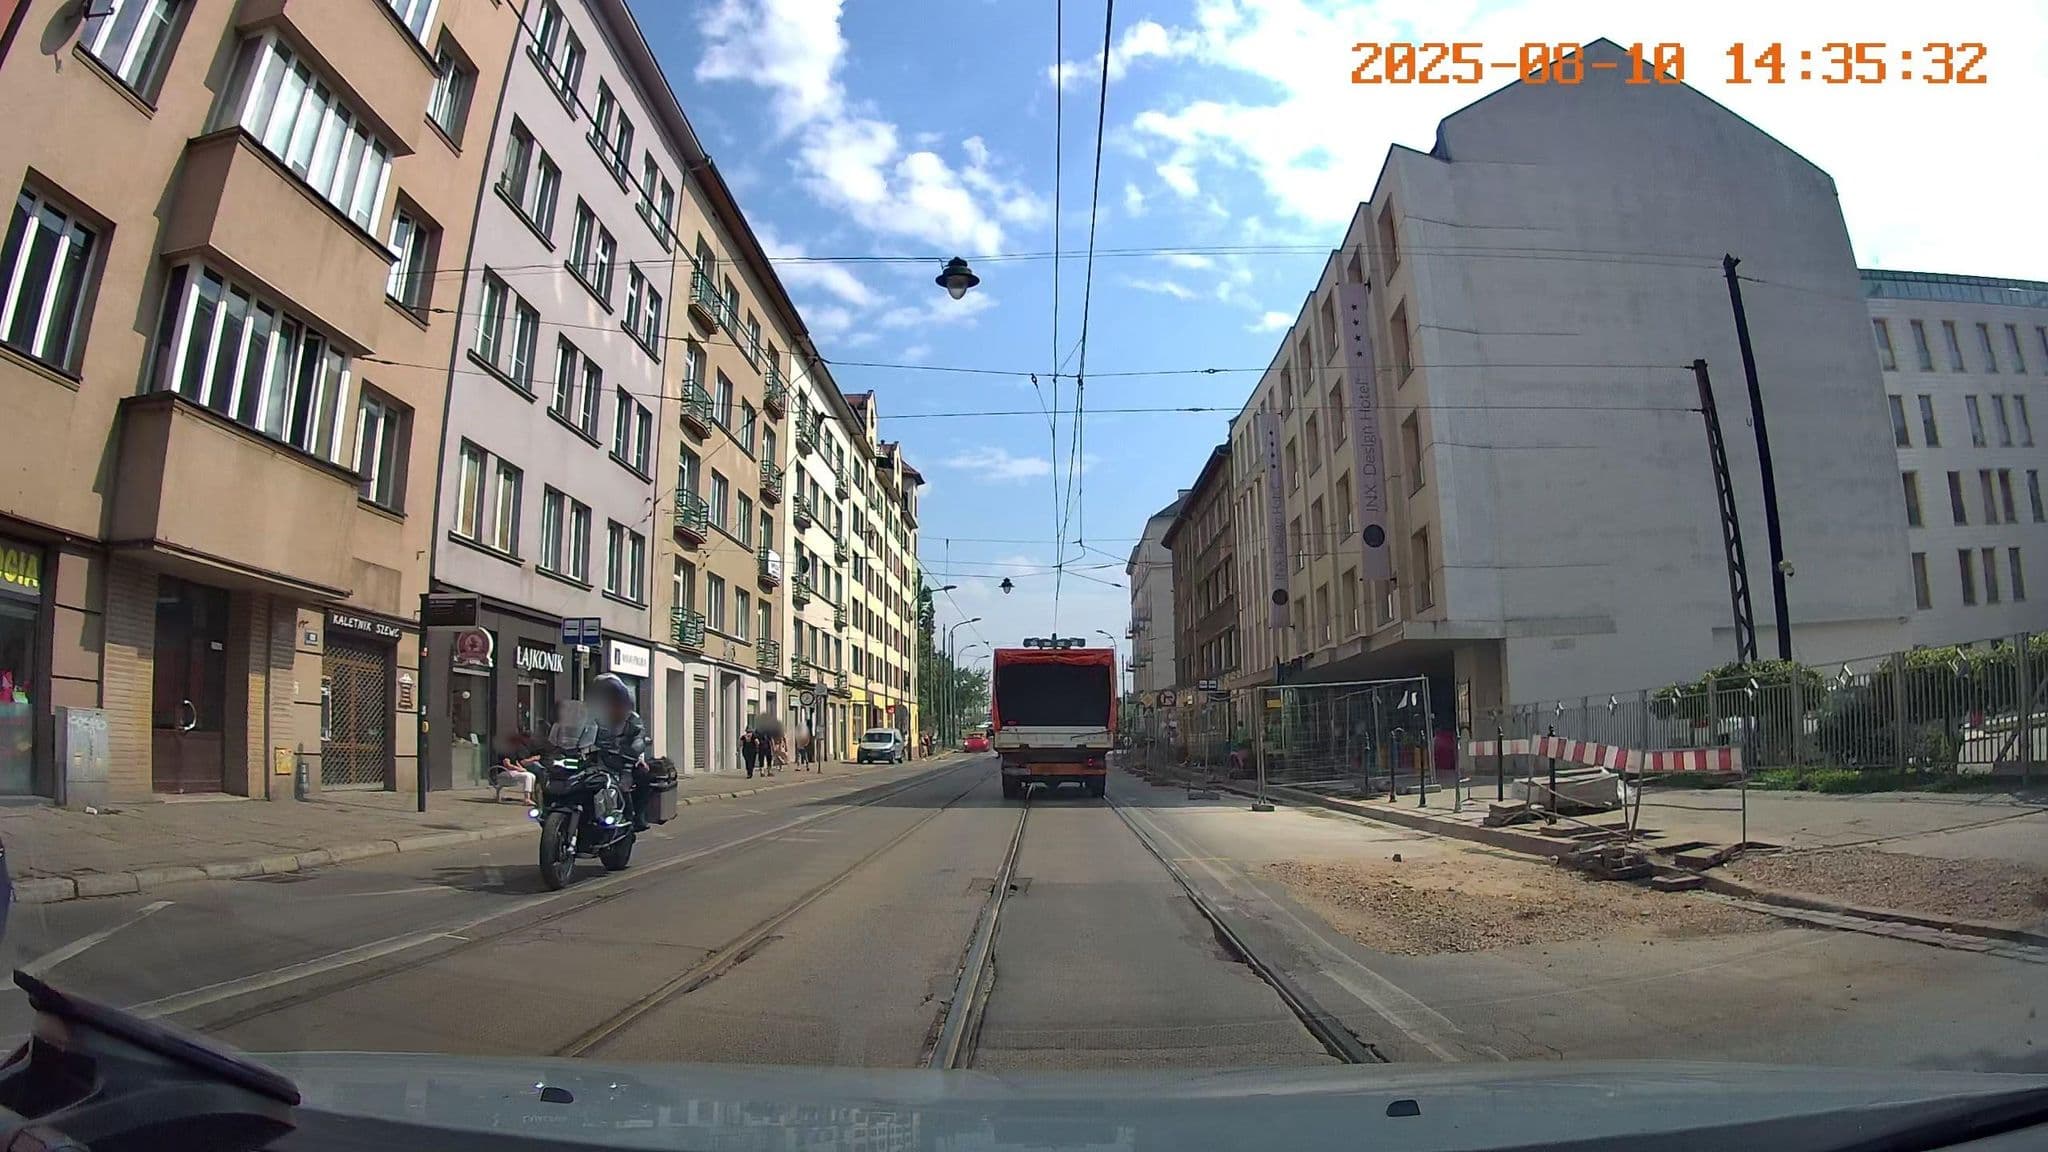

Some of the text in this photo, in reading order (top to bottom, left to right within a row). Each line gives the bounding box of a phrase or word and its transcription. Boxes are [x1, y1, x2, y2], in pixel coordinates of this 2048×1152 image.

[1359, 382, 1374, 420] Hotel
[1362, 425, 1378, 477] Design
[333, 613, 371, 632] KALETNIK
[516, 645, 564, 673] LAJKONIK
